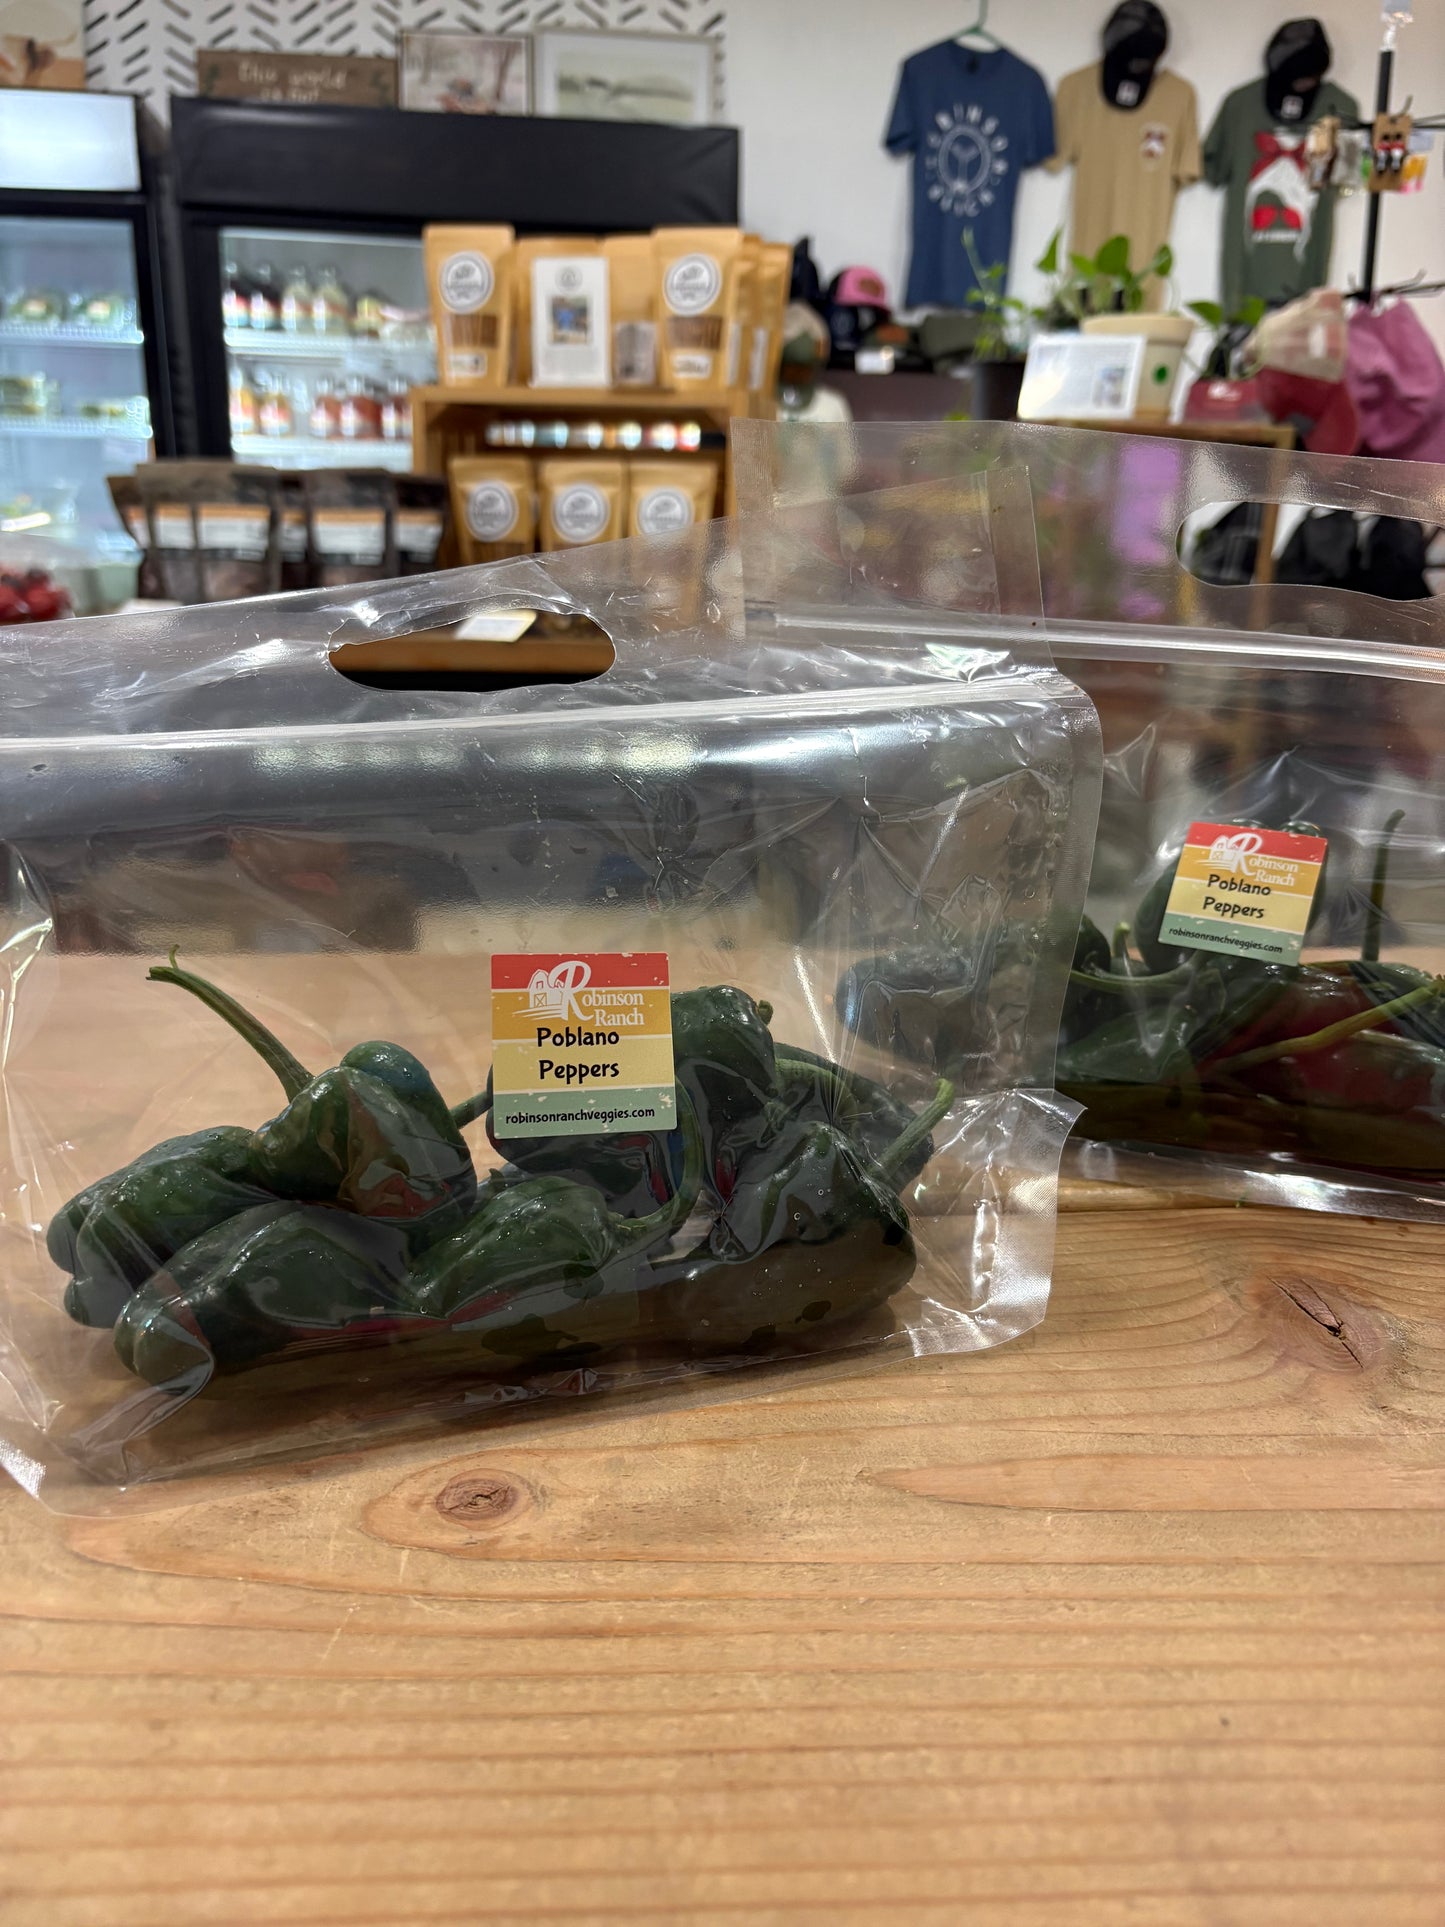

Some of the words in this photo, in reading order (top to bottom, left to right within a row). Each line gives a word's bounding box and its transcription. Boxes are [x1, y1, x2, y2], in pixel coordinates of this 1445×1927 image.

[1206, 873, 1272, 896] Poblano
[1254, 869, 1296, 887] Ranch
[1202, 896, 1265, 919] Peppers
[1168, 926, 1283, 954] robinsonranchveggies.com
[547, 960, 645, 1022] Robinson
[593, 1008, 645, 1027] Ranch
[536, 1025, 620, 1047] Poblano
[538, 1059, 620, 1084] Peppers
[505, 1107, 656, 1125] robinsonranchveggies.com
